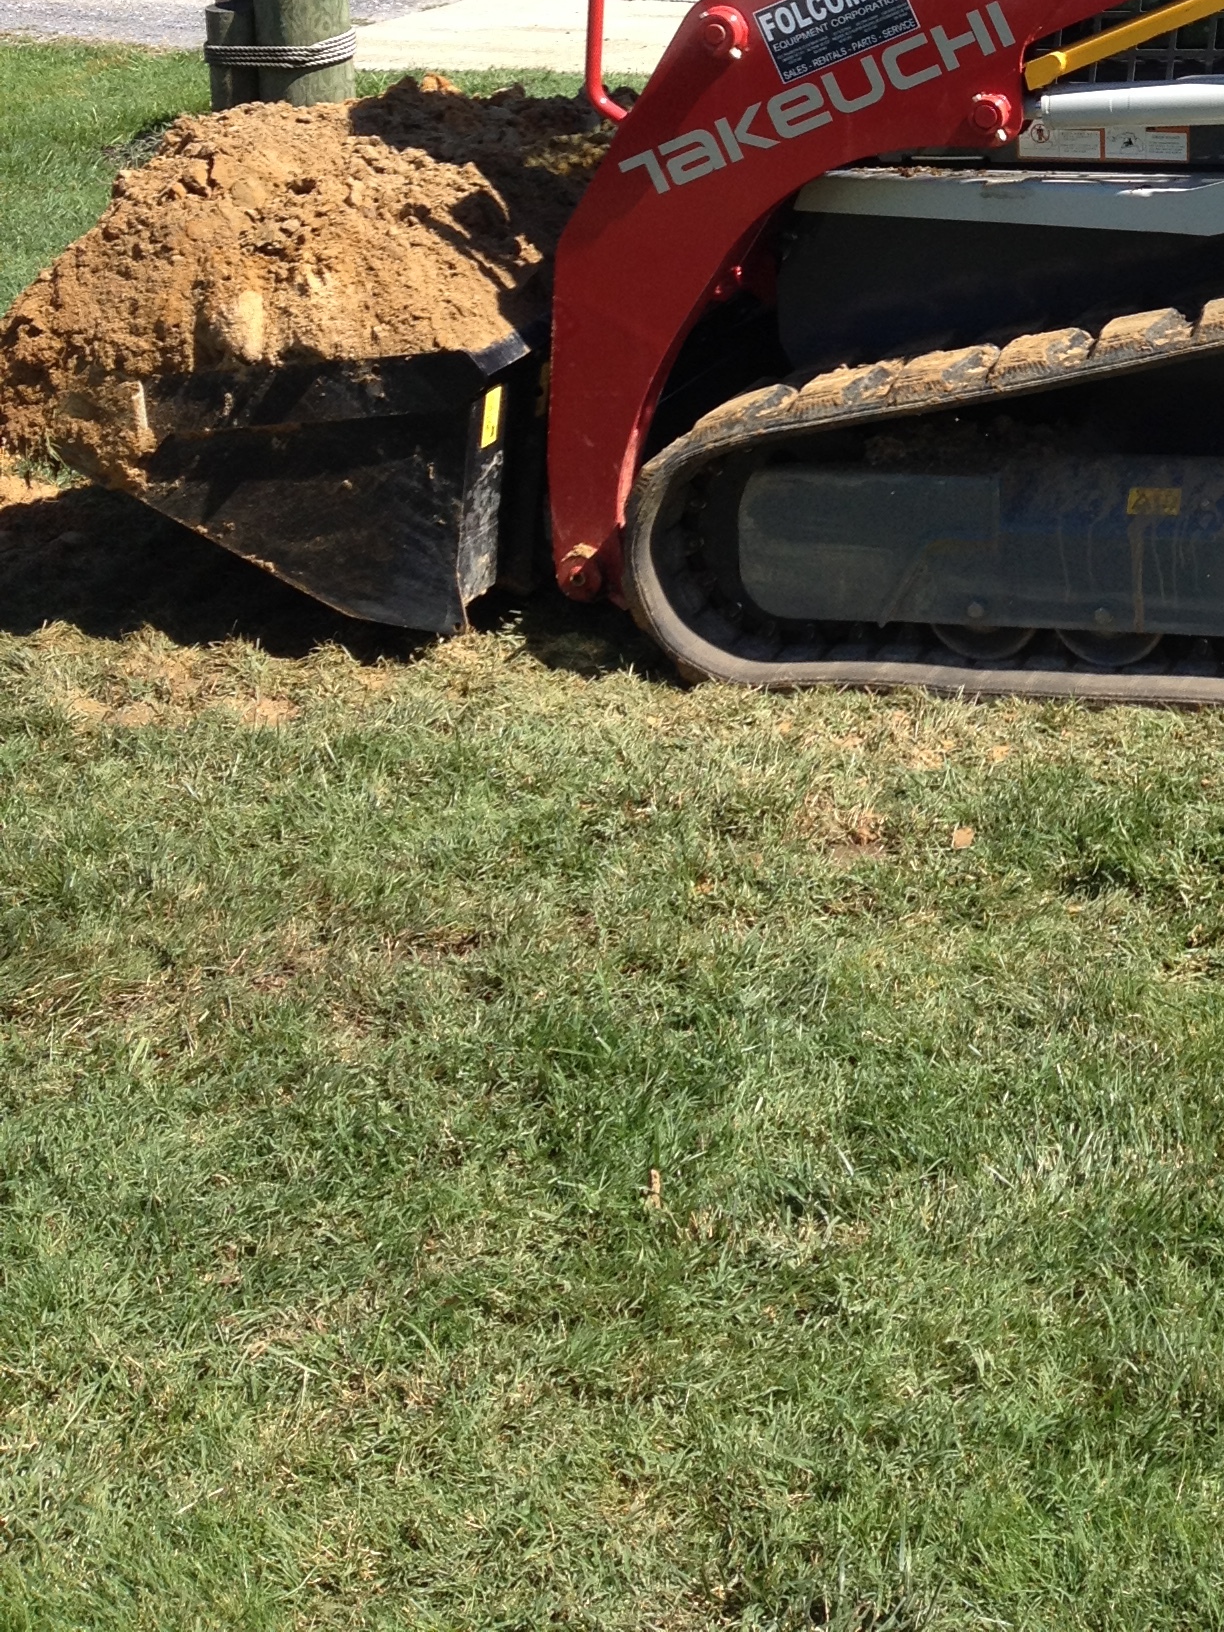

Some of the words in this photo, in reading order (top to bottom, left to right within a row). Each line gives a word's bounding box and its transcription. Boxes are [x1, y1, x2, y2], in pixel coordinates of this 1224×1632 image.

[772, 22, 829, 52] EQUIPMENT
[783, 63, 808, 80] SALES
[813, 47, 848, 68] RENTALS
[851, 34, 877, 53] PARTS
[882, 18, 916, 39] SERVICE
